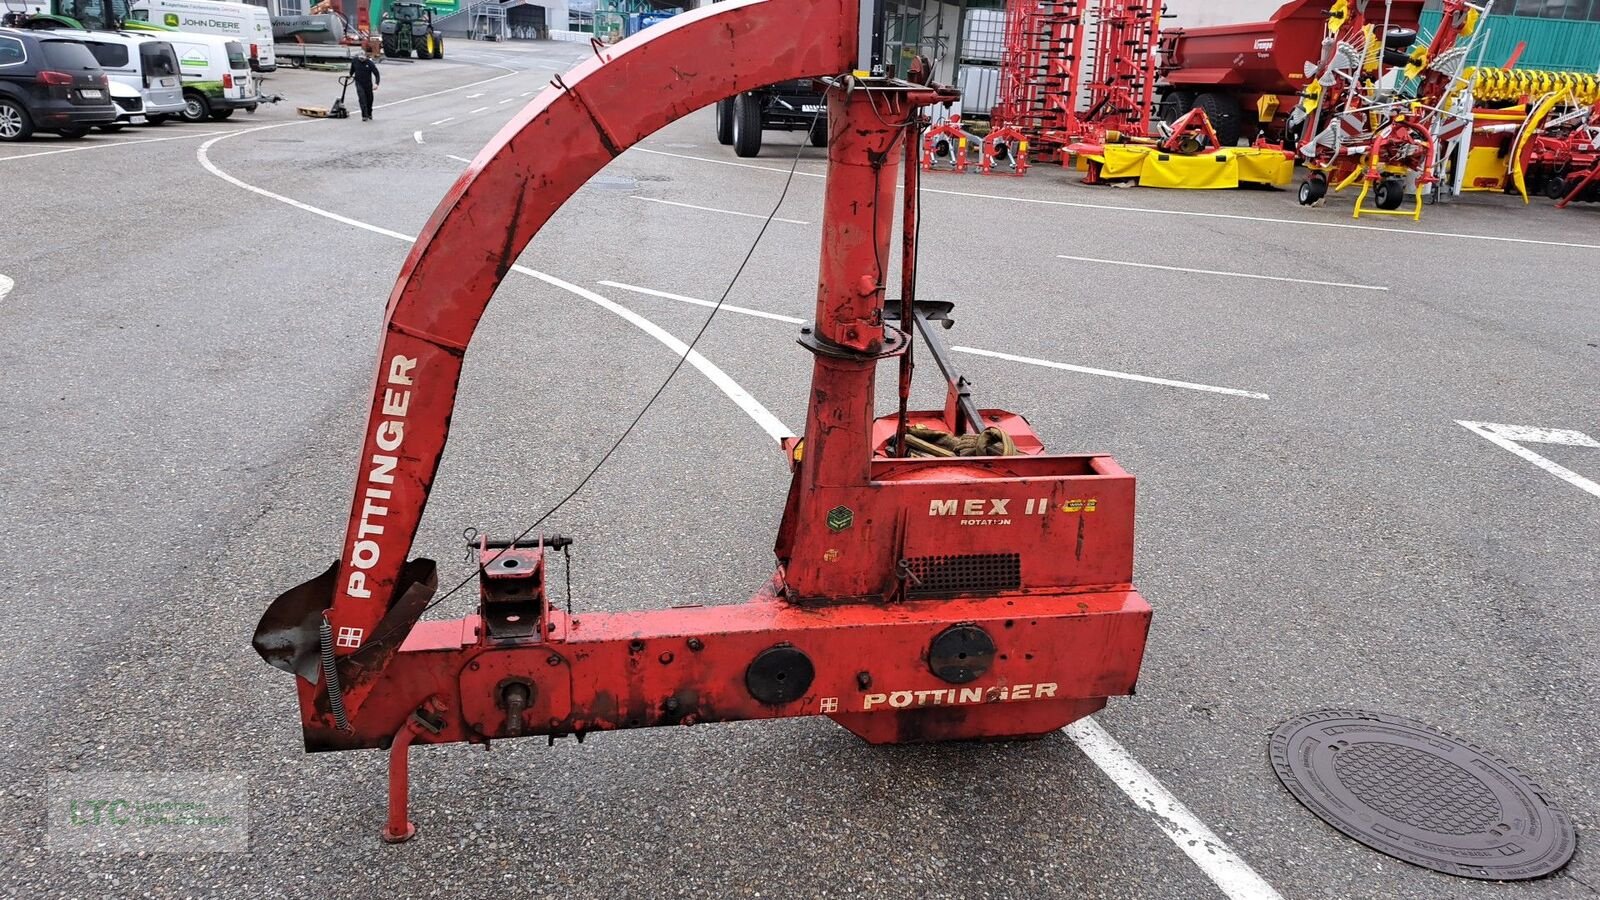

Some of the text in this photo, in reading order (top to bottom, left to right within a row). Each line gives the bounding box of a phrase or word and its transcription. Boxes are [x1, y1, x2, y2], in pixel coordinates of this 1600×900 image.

[182, 18, 240, 29] JOHN DEERE
[347, 354, 418, 599] PÖTTINGER
[928, 498, 1012, 516] MEX
[863, 682, 1058, 710] PÖTTINGER
